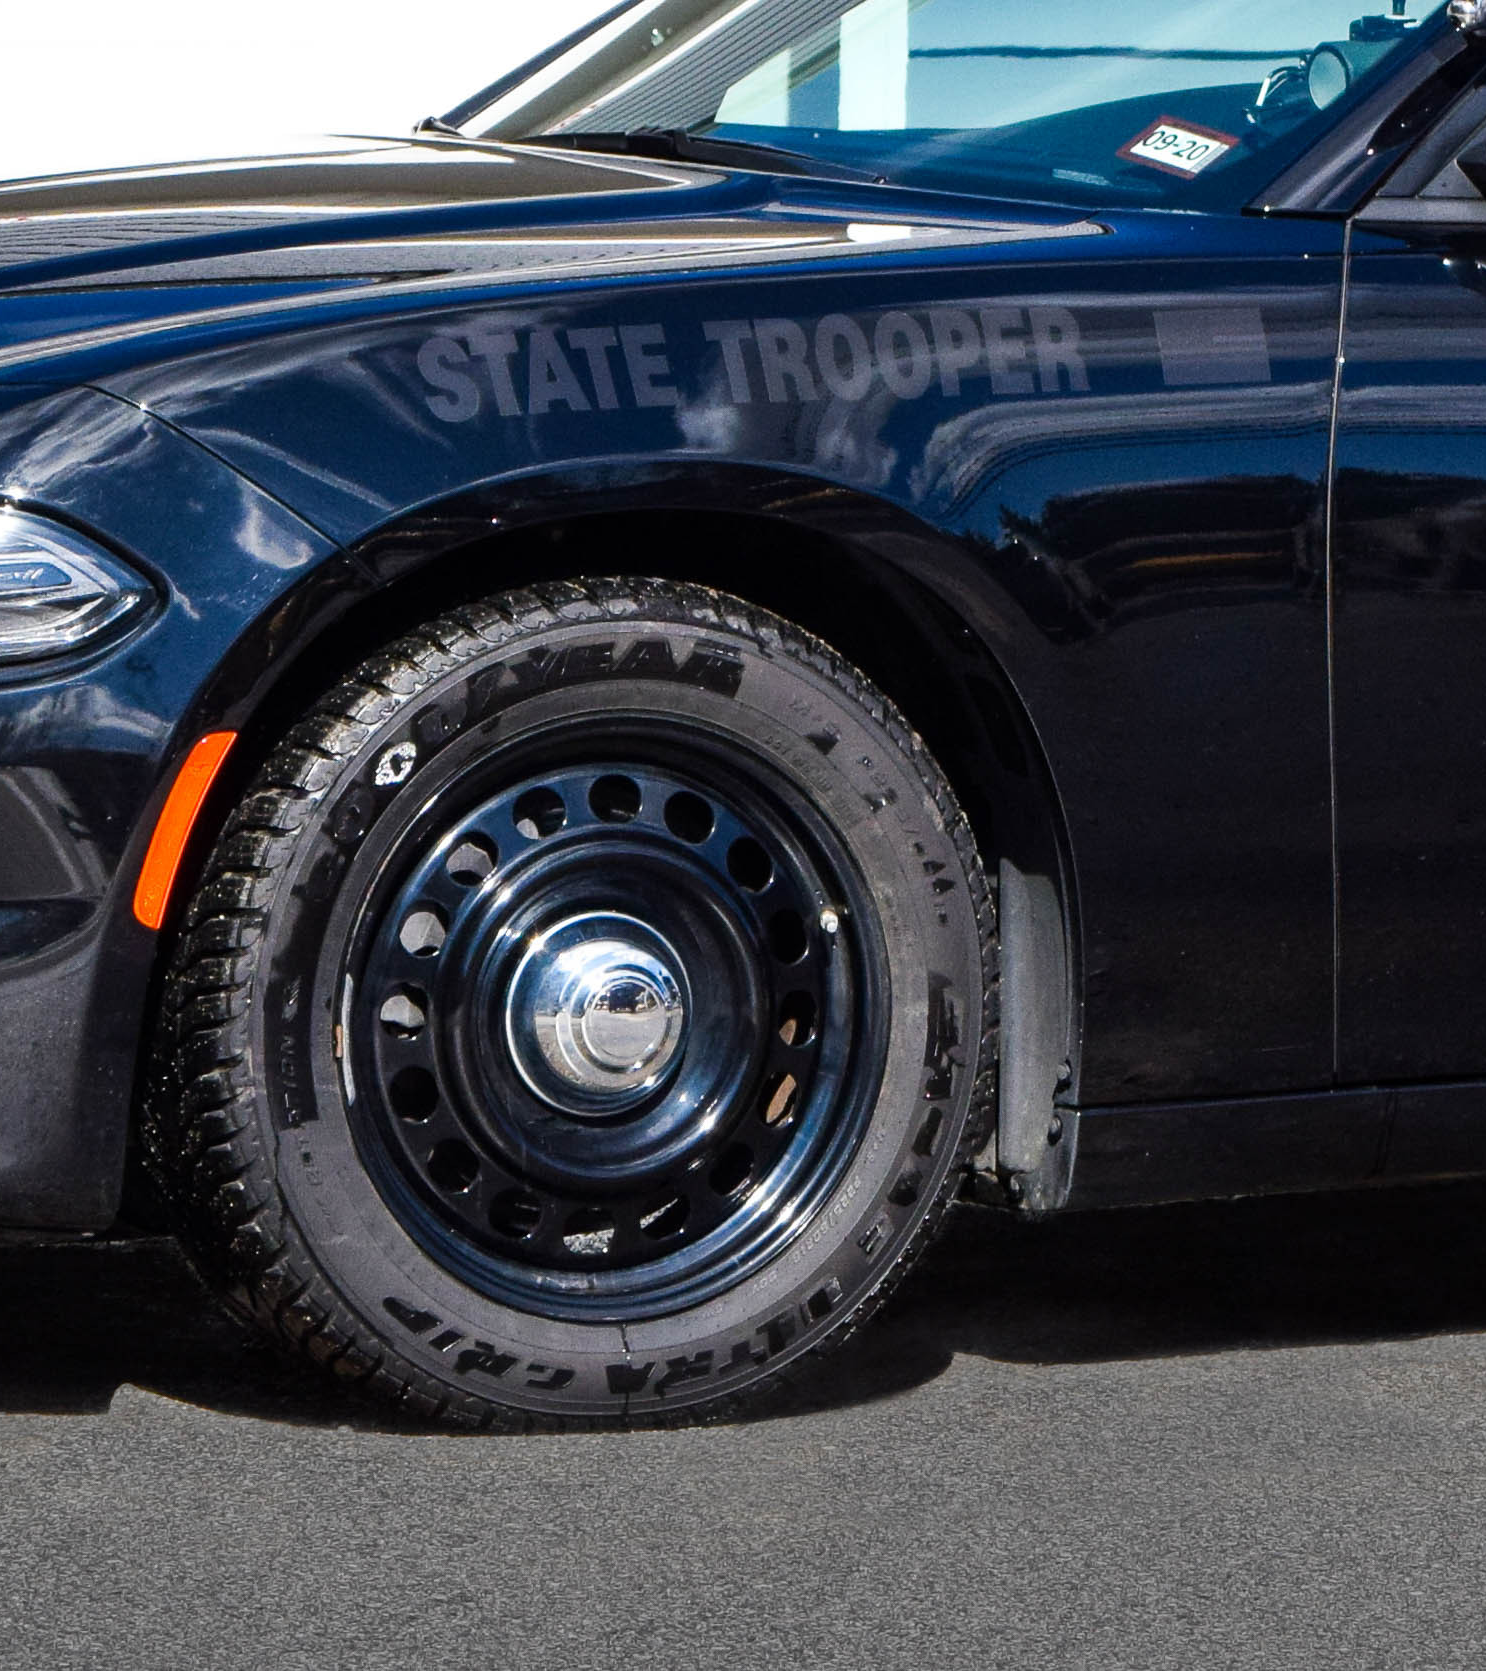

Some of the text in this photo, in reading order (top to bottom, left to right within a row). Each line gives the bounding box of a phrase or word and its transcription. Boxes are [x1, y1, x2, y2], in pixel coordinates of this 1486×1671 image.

[1143, 130, 1210, 161] 09-20
[416, 306, 1091, 424] STATE TROOPER
